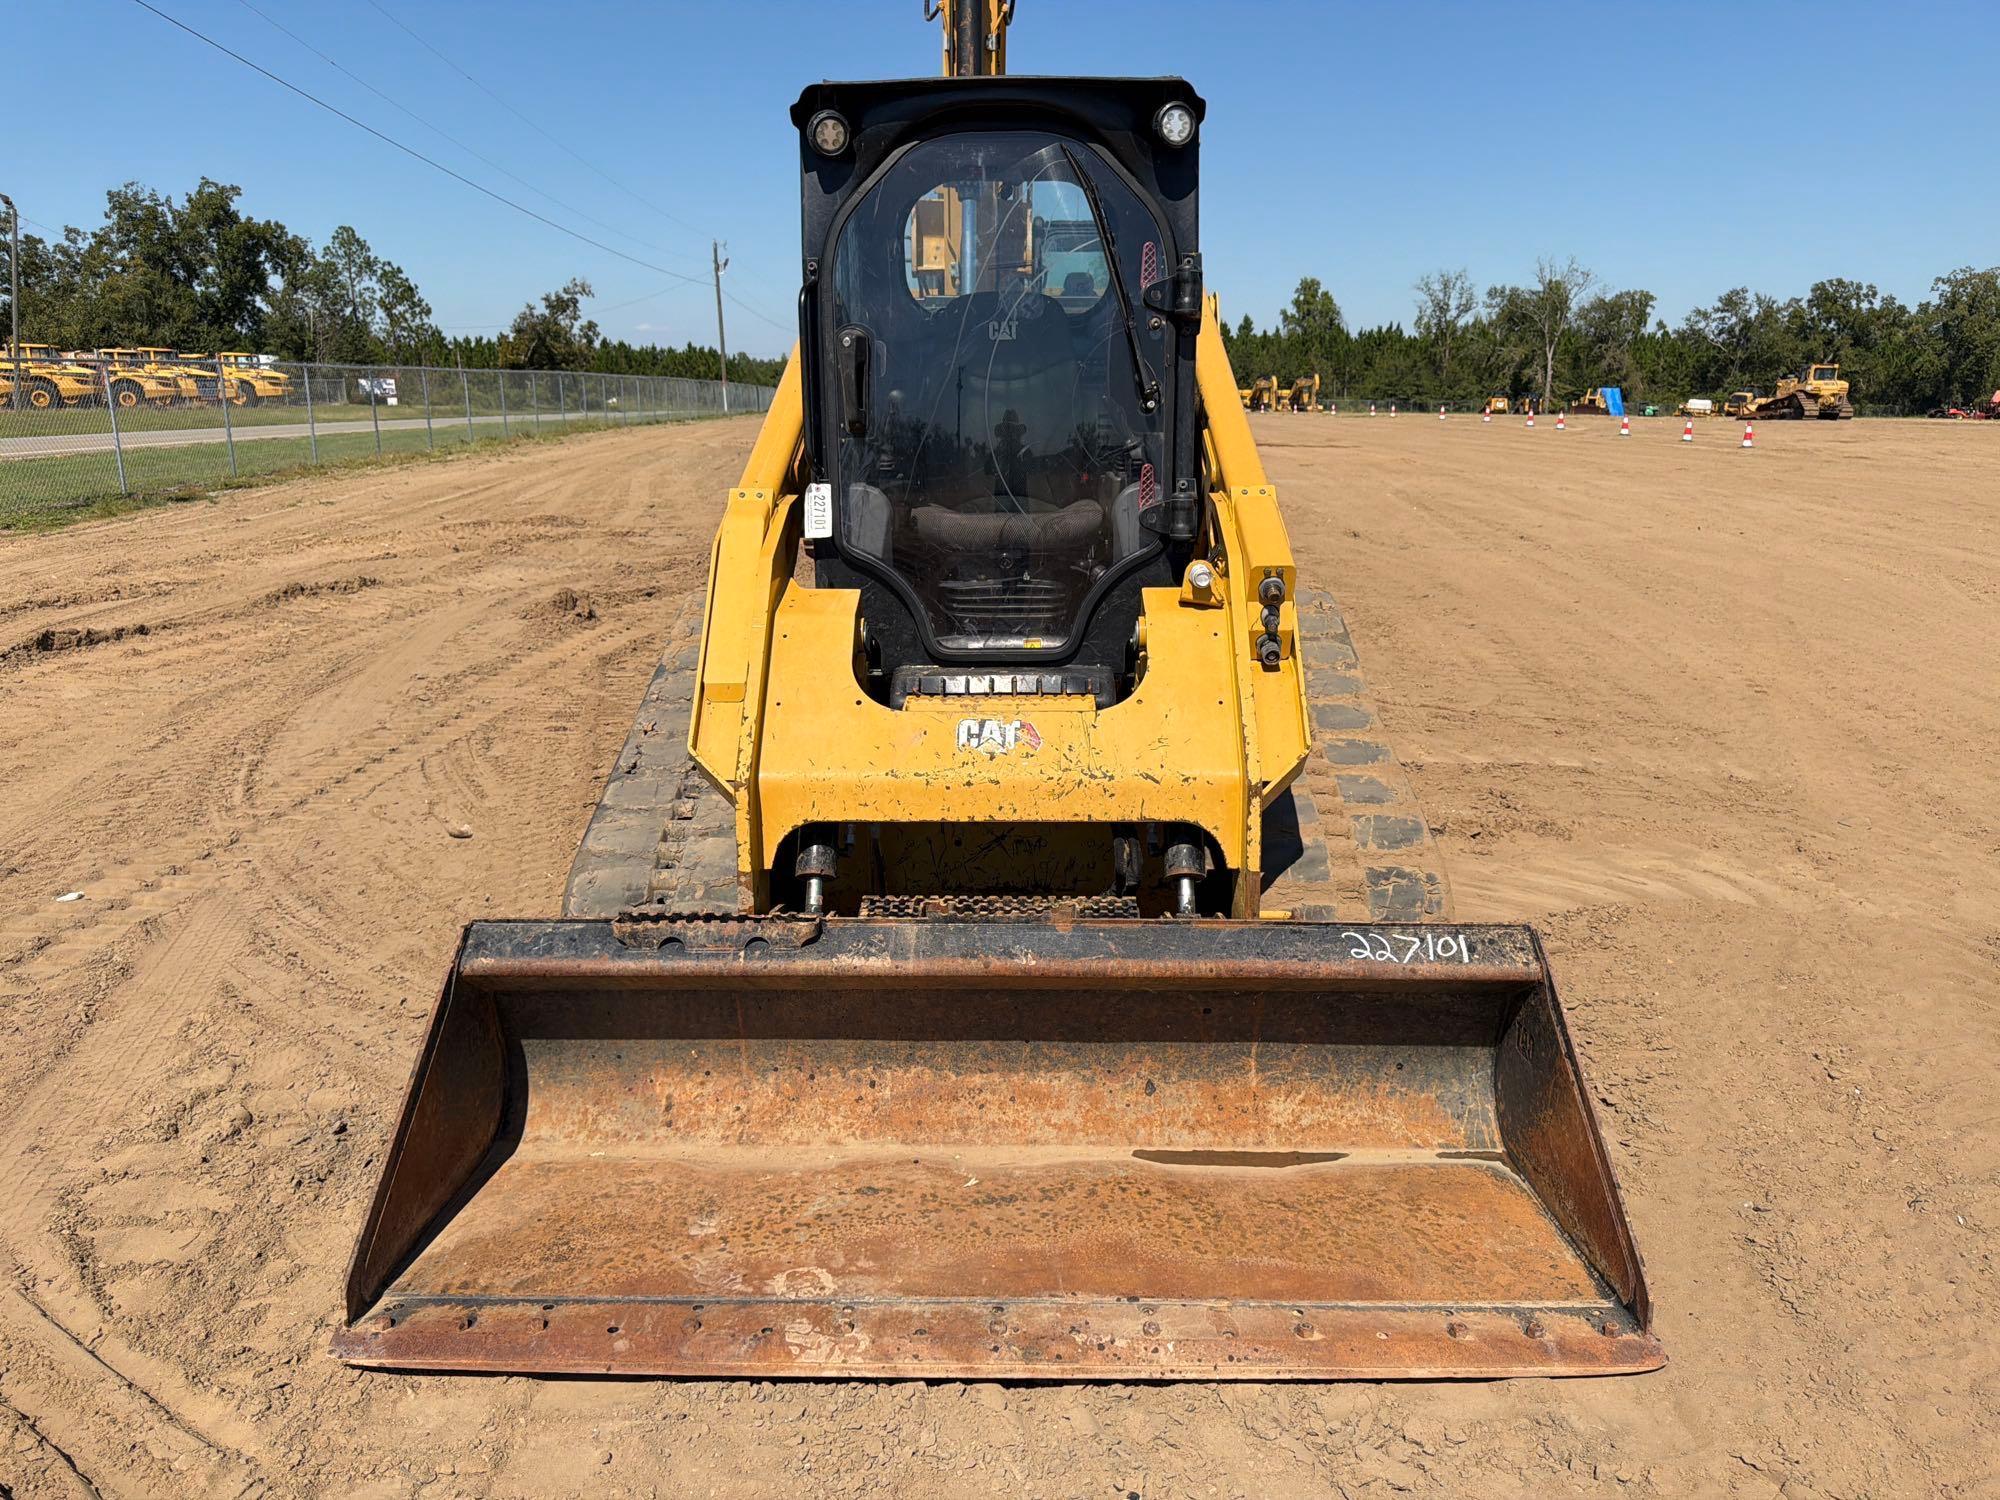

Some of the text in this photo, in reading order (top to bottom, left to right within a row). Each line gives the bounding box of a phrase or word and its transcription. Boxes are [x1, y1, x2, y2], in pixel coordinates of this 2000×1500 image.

[988, 320, 1018, 340] CAT
[813, 494, 826, 530] 227101
[957, 718, 1021, 754] CAT
[1341, 931, 1469, 964] 227101
